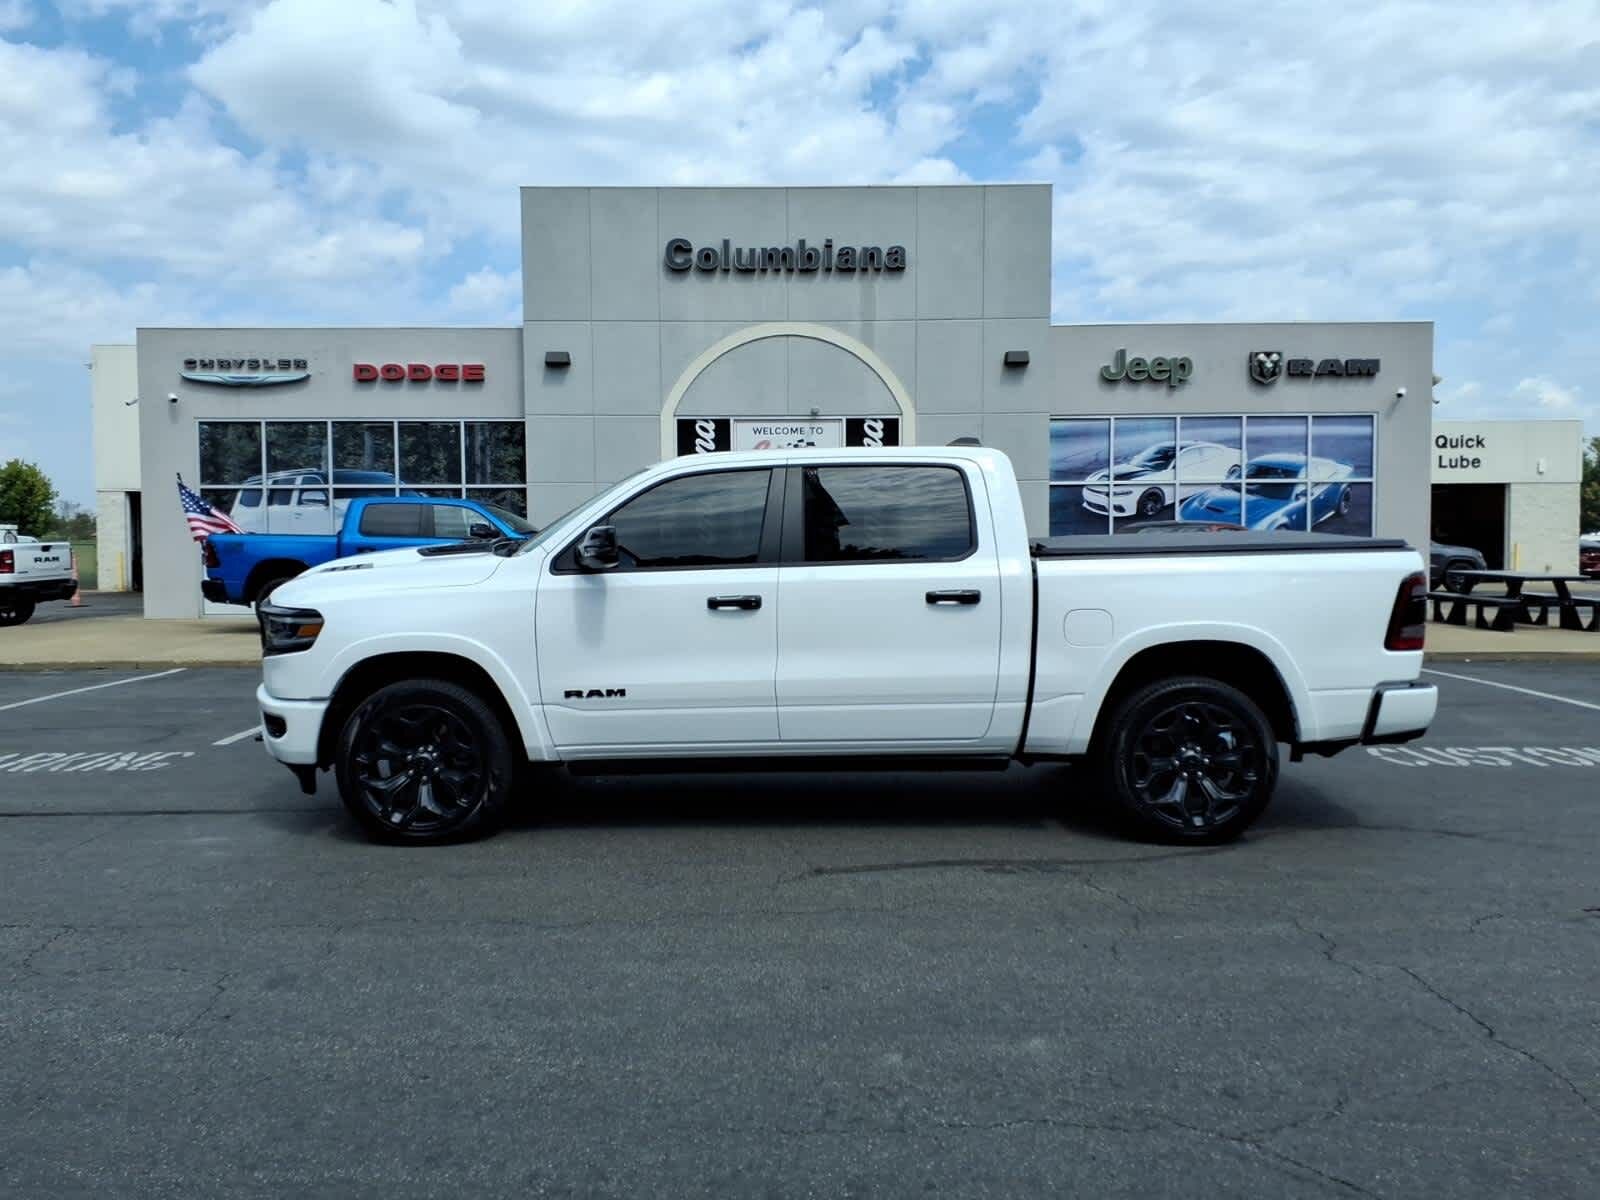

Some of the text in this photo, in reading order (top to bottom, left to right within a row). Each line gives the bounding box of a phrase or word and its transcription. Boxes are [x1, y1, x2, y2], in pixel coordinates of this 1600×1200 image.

[665, 238, 906, 271] Columbiana
[183, 359, 308, 369] CHRYSLER
[1101, 348, 1193, 387] Jeep
[1287, 358, 1380, 376] RAM
[353, 363, 485, 382] DODGE
[752, 426, 824, 436] WELCOME TO
[1435, 434, 1486, 449] Quick
[1438, 455, 1481, 469] Lube
[564, 688, 626, 699] RAM
